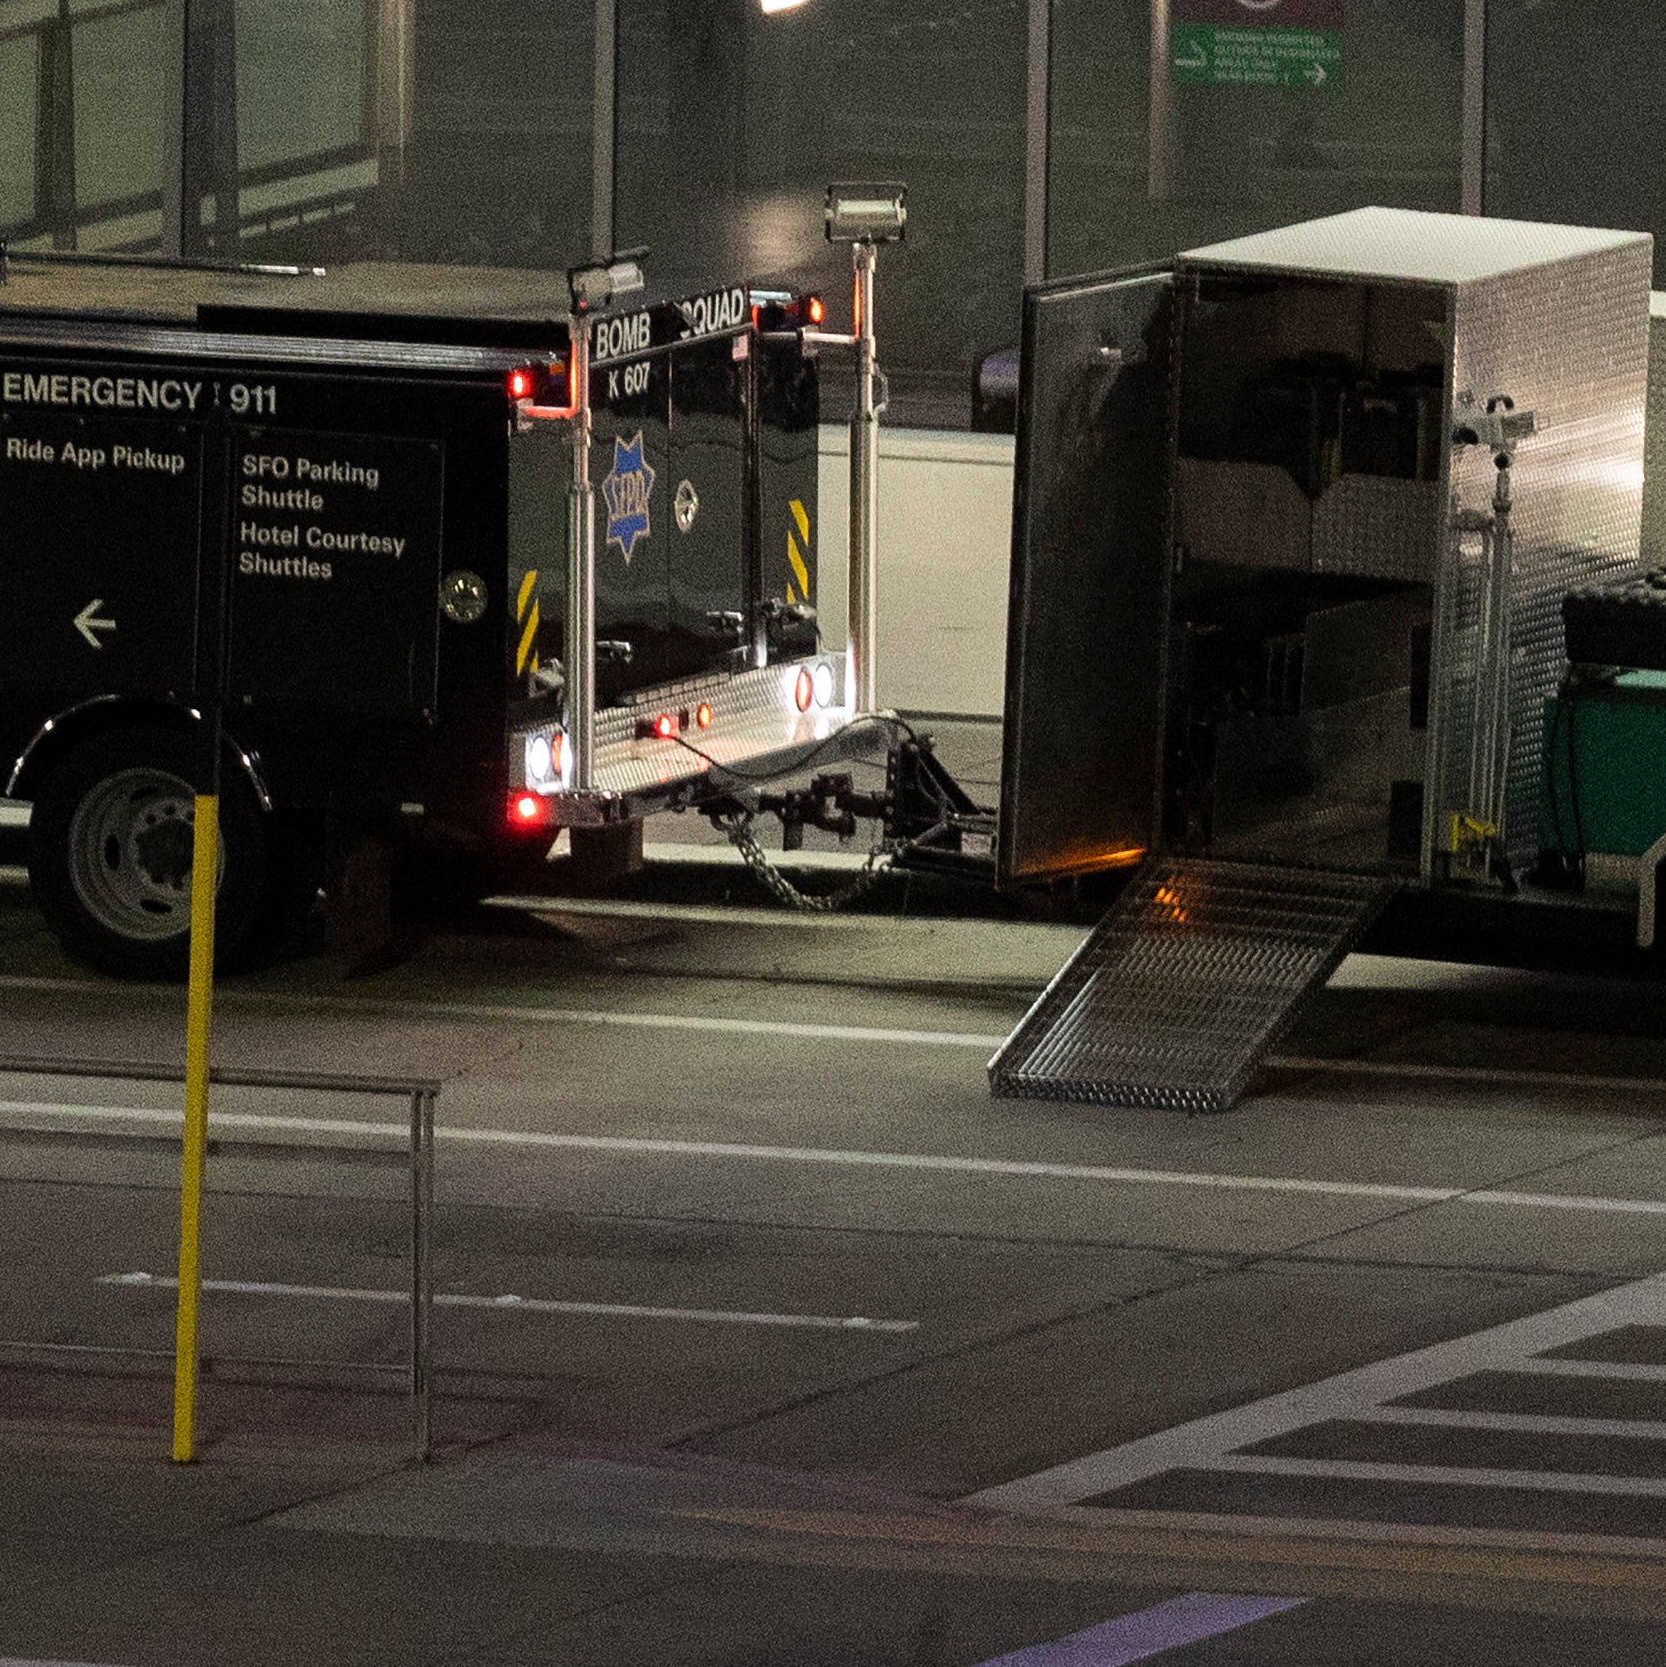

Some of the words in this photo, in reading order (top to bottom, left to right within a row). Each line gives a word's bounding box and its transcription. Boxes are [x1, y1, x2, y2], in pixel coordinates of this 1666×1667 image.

[596, 312, 651, 360] BOMB
[3, 372, 202, 411] EMERGENCY
[229, 383, 277, 414] 911
[609, 369, 619, 400] K
[624, 361, 651, 396] 607
[6, 437, 55, 462] Ride
[61, 441, 106, 470] App
[113, 445, 185, 475] Pickup
[242, 454, 289, 479] SFO
[296, 457, 380, 490] Parking
[241, 484, 324, 511] Shuttle
[240, 521, 300, 547] Hotel
[305, 526, 406, 560] Courtesy
[239, 551, 332, 580] Shuttles
